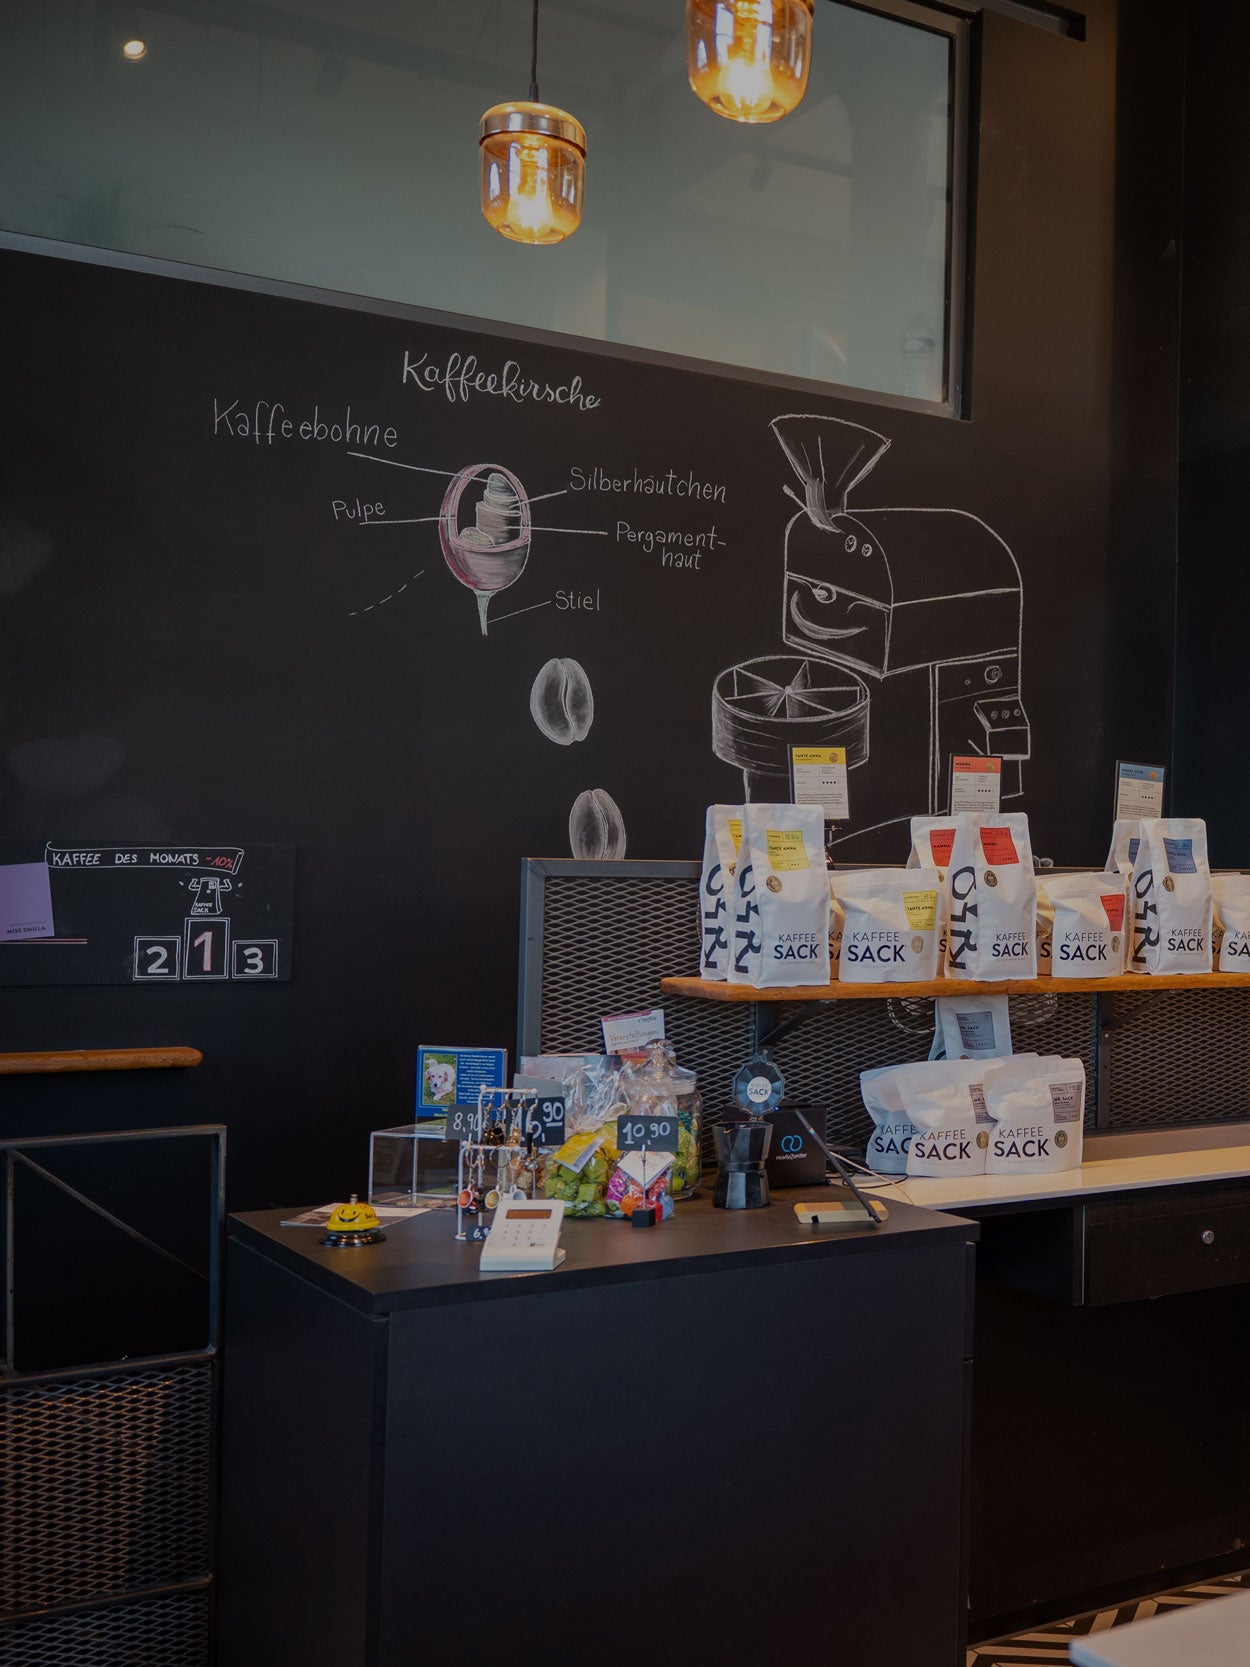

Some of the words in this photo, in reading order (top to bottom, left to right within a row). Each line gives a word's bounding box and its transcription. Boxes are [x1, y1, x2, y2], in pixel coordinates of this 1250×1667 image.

[401, 350, 601, 411] Kaffeekirsche
[213, 398, 399, 448] Kaffeebohne
[570, 467, 727, 504] Silberhäutchen
[332, 499, 387, 522] Pulpe
[616, 521, 727, 553] Pergament-
[662, 546, 702, 570] haut
[555, 589, 600, 612] Stiel
[52, 853, 101, 866] KAFFEE
[115, 853, 138, 864] DES
[150, 853, 200, 865] MONATS
[205, 856, 234, 869] -10%
[22, 925, 46, 933] SMILLA
[853, 932, 900, 942] KAFFEE
[996, 932, 1026, 942] KAFFEE
[1065, 932, 1103, 942] KAFFEE
[1171, 928, 1202, 937] KAFFEE
[778, 933, 816, 943] KAFFEE
[1168, 938, 1204, 951] SACK
[193, 930, 213, 972] 1
[774, 944, 819, 960] SACK
[848, 945, 905, 962] SACK
[992, 942, 1028, 957] SACK
[1060, 944, 1107, 961] SACK
[146, 946, 169, 974] 2
[243, 947, 264, 974] 3
[622, 1122, 671, 1145] 10,90
[920, 1129, 966, 1141] KAFFEE
[999, 1127, 1043, 1139] KAFFEE
[776, 1152, 807, 1161] ready2order
[915, 1141, 971, 1161] SACK
[994, 1139, 1050, 1158] SACK
